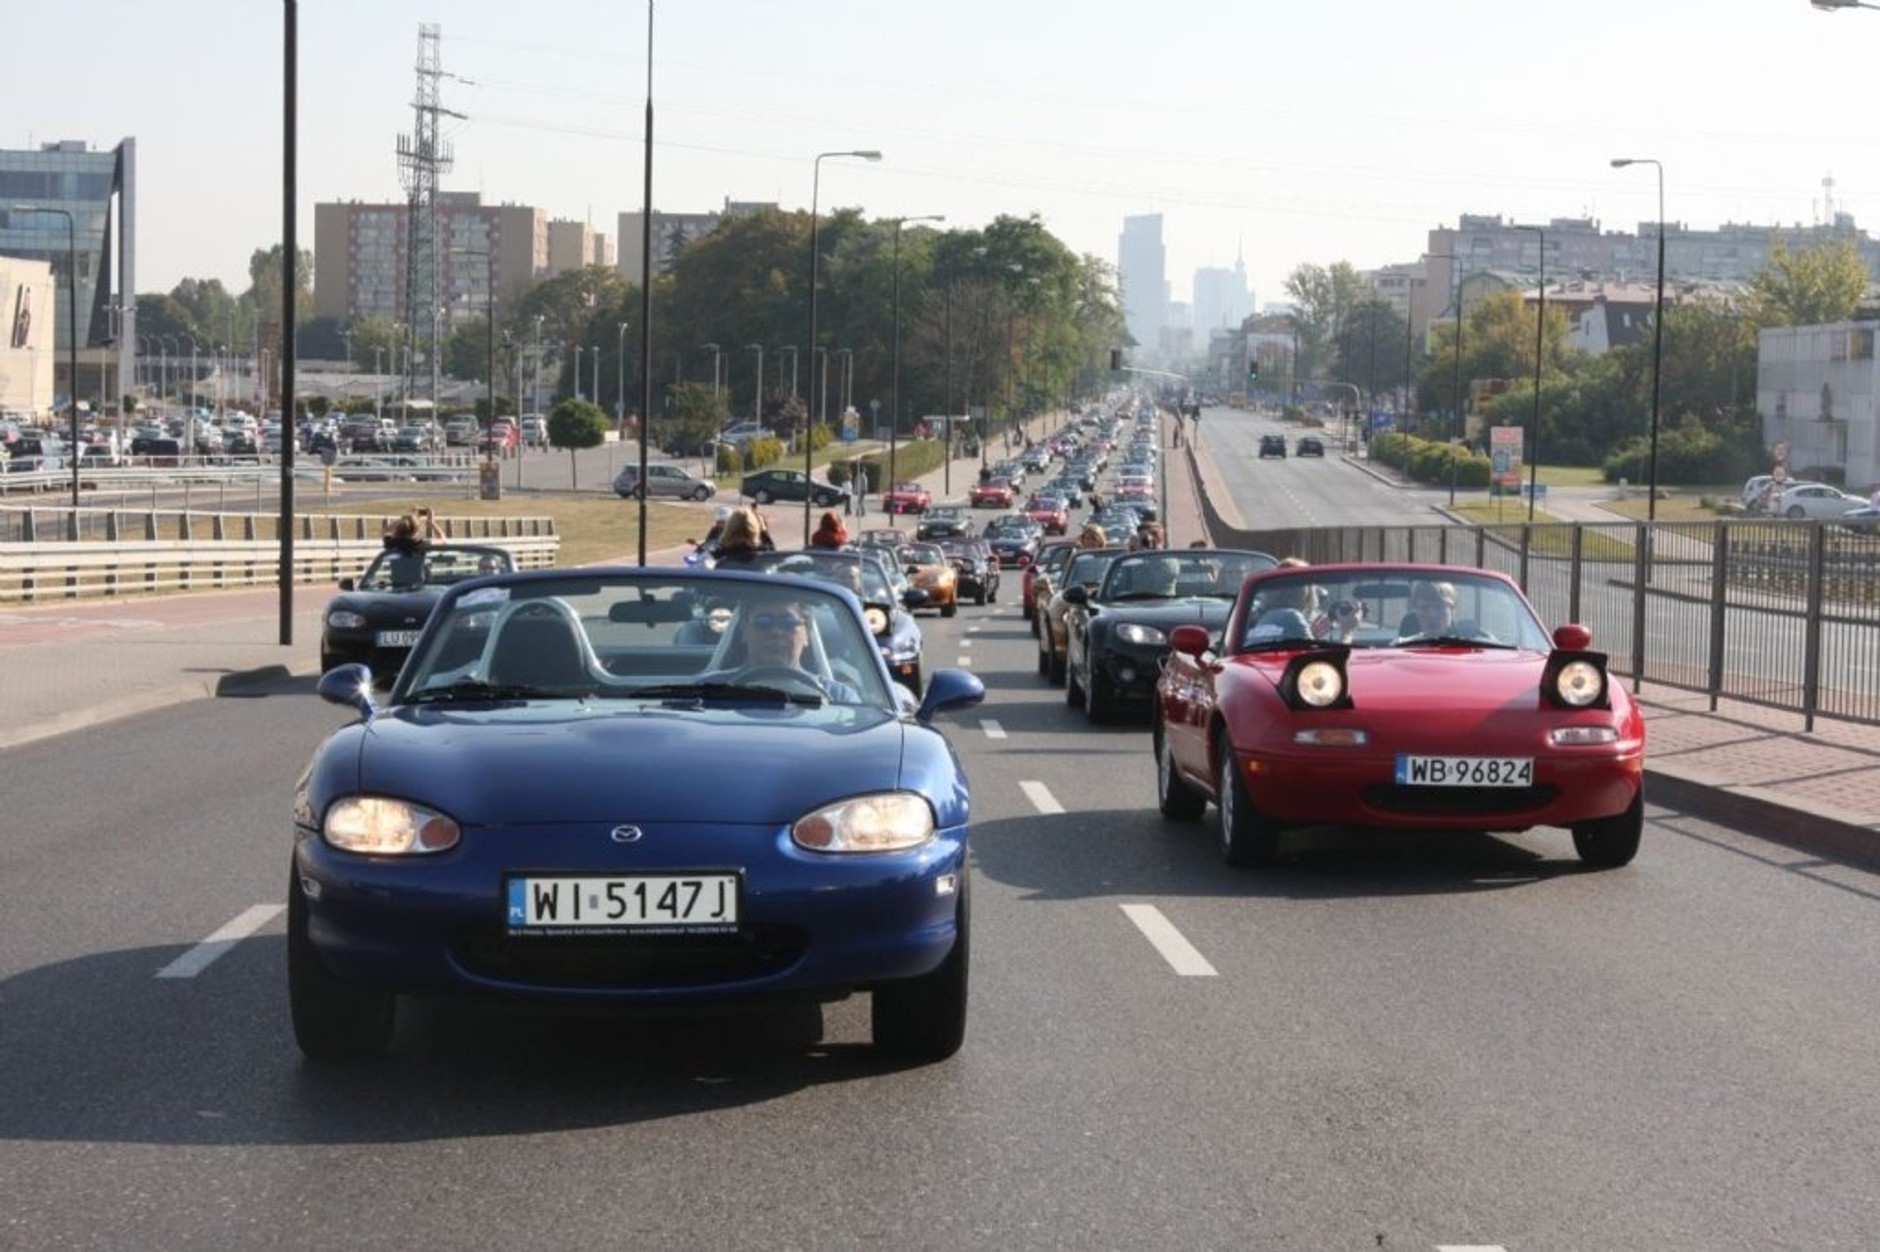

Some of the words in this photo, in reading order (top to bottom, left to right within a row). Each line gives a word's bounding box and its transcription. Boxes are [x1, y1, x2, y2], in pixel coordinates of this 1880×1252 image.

[1411, 758, 1447, 783] WB
[1455, 759, 1532, 784] 96824
[533, 882, 581, 921] WI
[605, 880, 726, 919] 5147J
